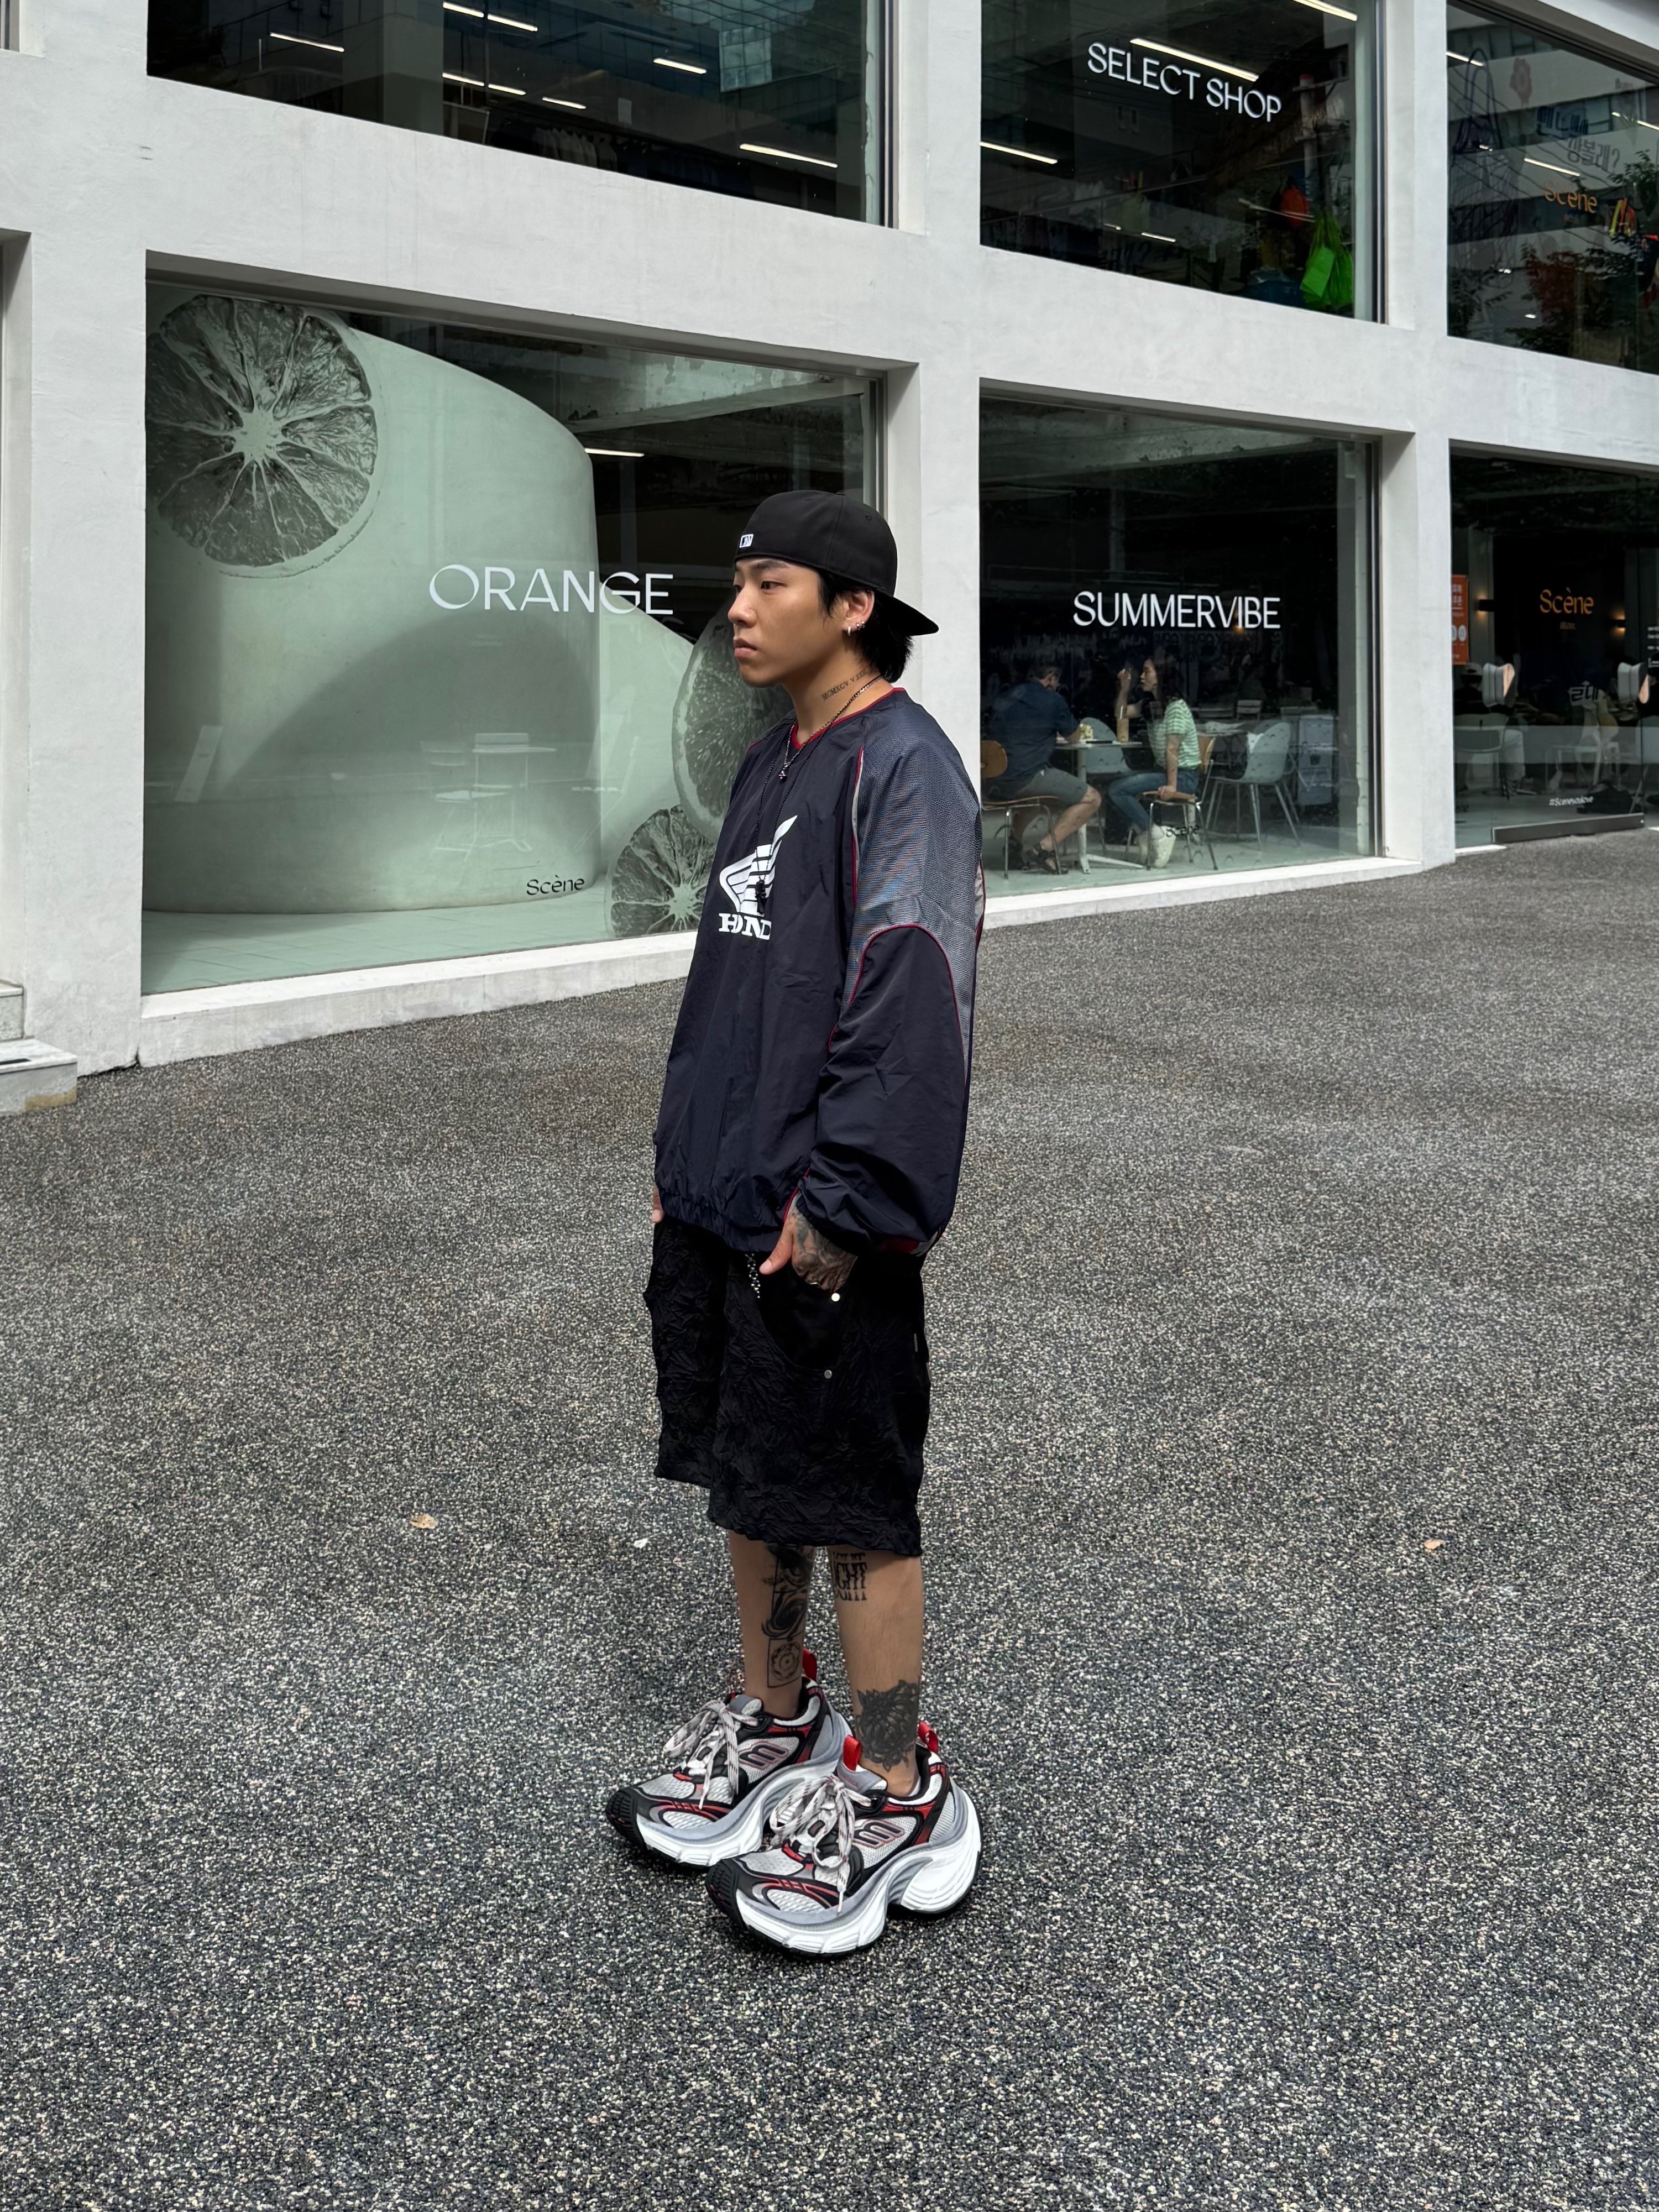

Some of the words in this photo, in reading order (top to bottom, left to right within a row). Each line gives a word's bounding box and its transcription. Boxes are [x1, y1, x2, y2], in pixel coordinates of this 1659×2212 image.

[1087, 42, 1201, 100] SELECT
[1206, 77, 1282, 123] SHOP
[429, 564, 674, 615] ORANGE
[1540, 586, 1594, 614] Scène
[1073, 590, 1281, 629] SUMMERVIBE
[526, 874, 585, 896] Scène
